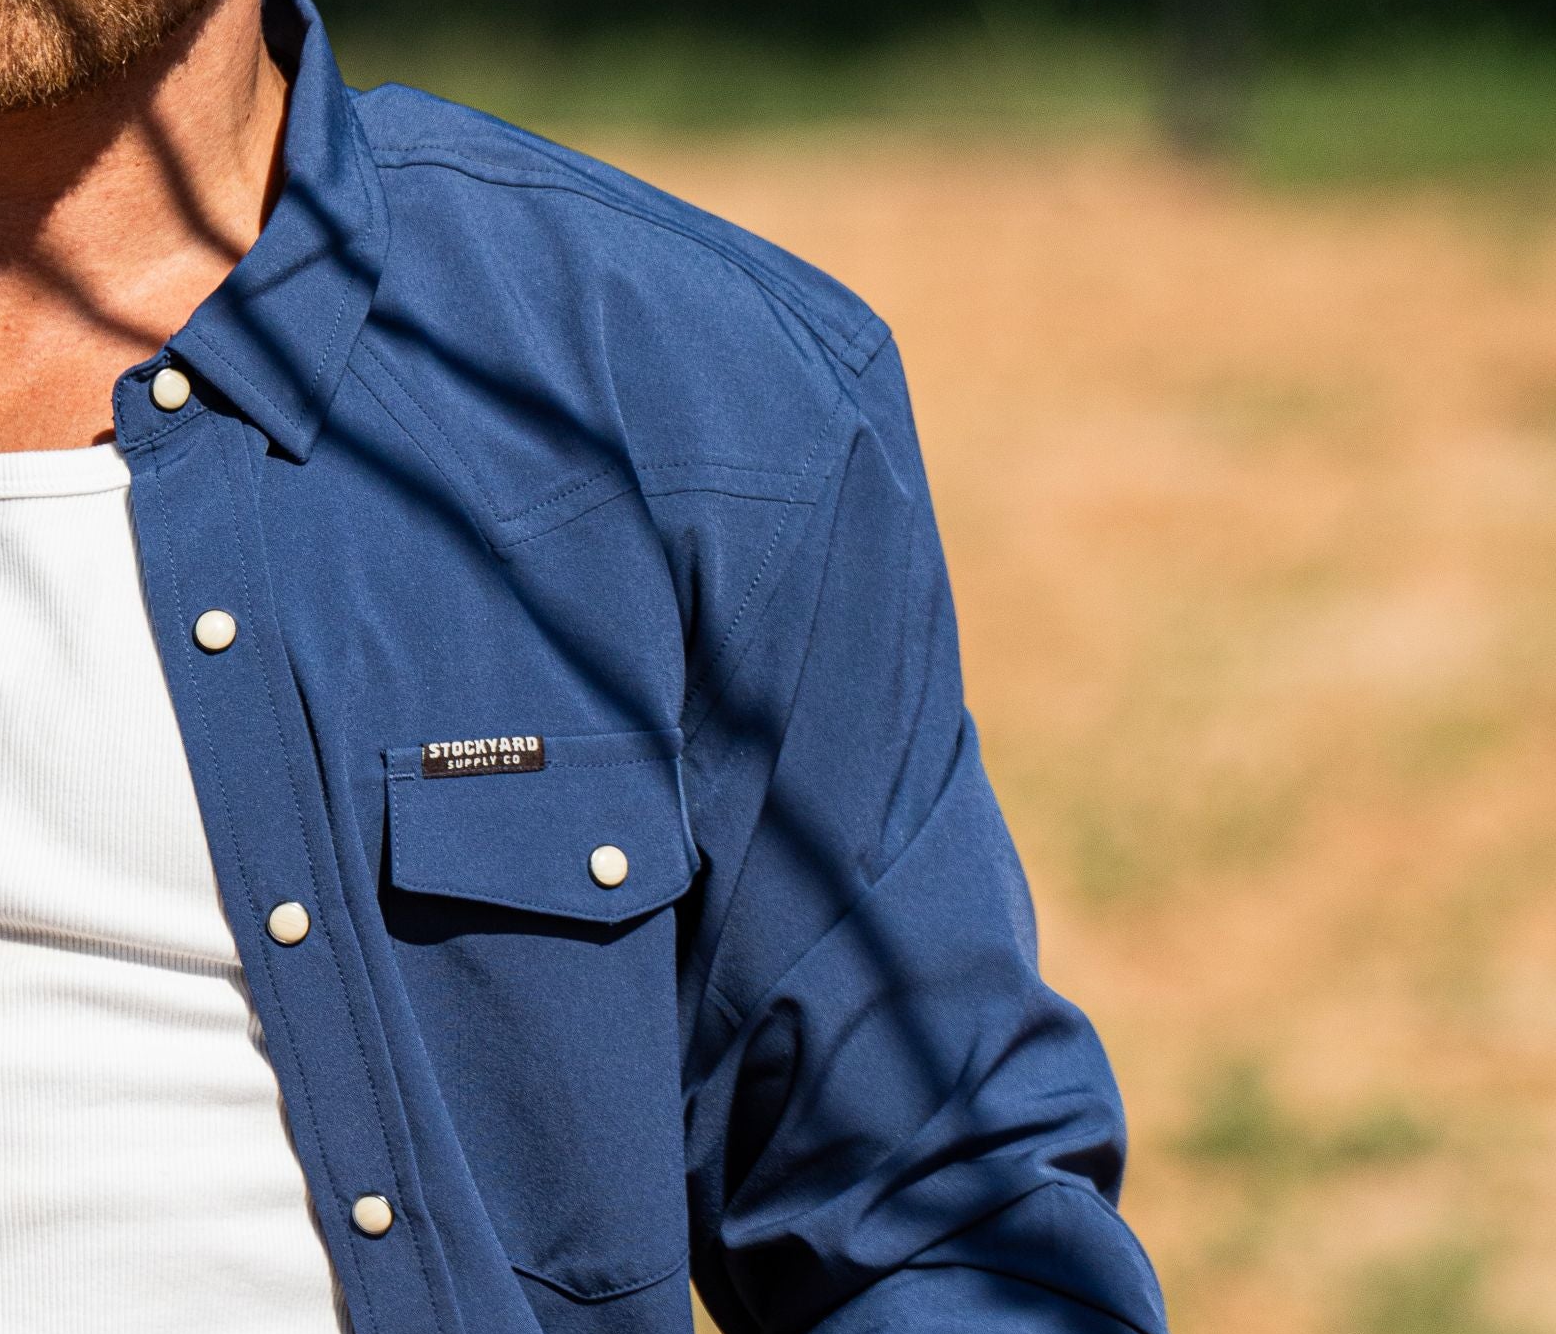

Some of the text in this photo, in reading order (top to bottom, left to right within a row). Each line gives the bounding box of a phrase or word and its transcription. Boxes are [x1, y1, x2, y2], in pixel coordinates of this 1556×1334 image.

[428, 736, 539, 759] STOCKYARD
[447, 754, 521, 770] SUPPLY CO
